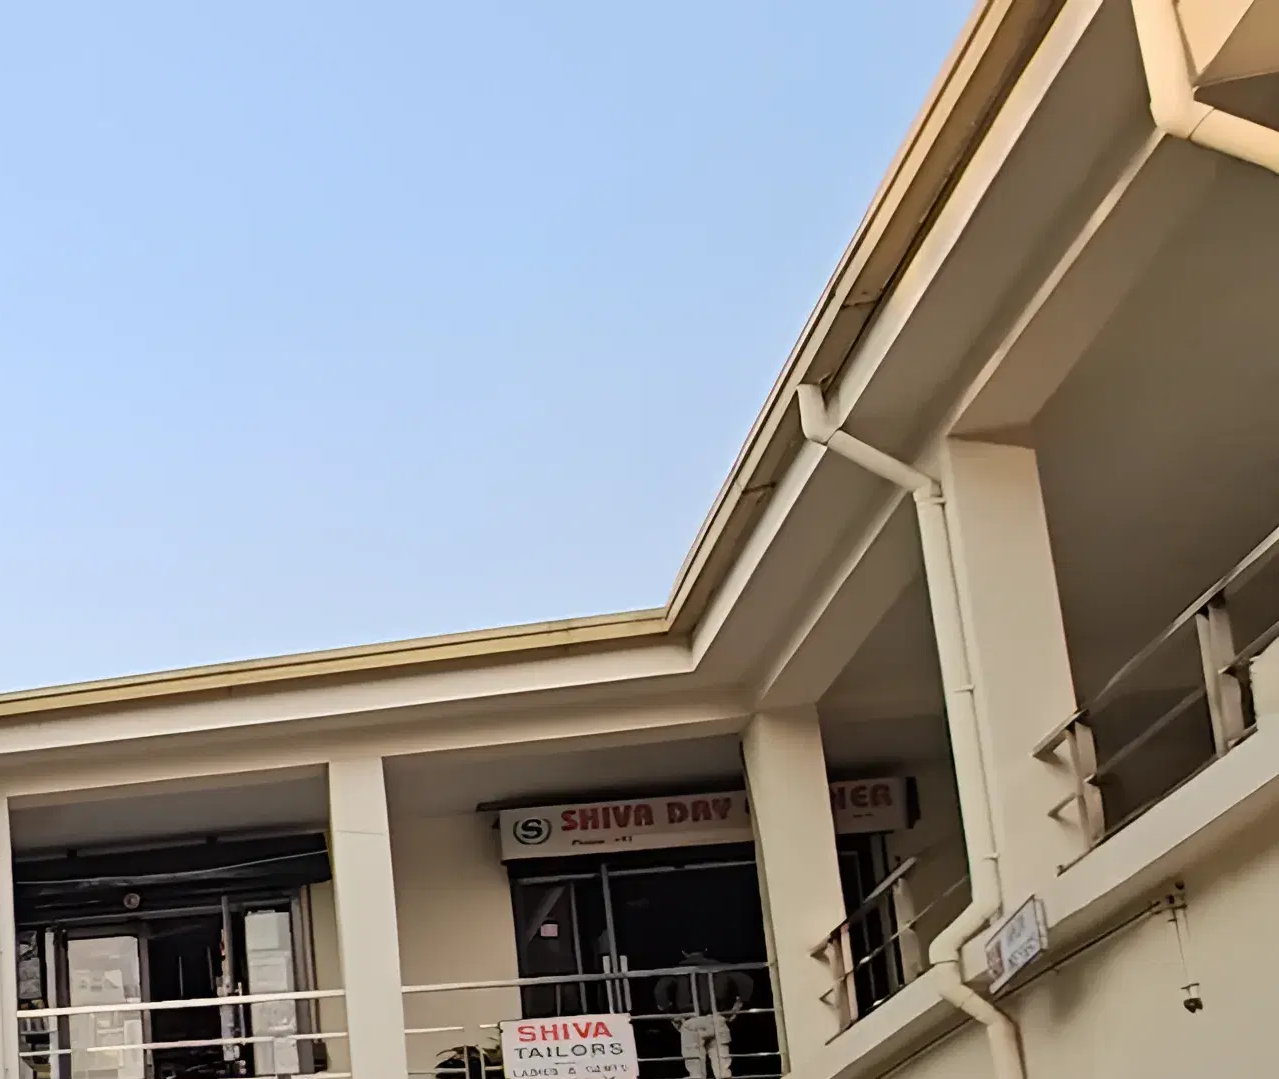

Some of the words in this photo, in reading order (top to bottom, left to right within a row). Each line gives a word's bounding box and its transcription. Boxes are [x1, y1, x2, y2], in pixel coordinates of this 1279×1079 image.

[560, 804, 654, 831] SHIVA
[517, 1022, 613, 1042] SHIVA
[514, 1042, 623, 1059] TAILORS
